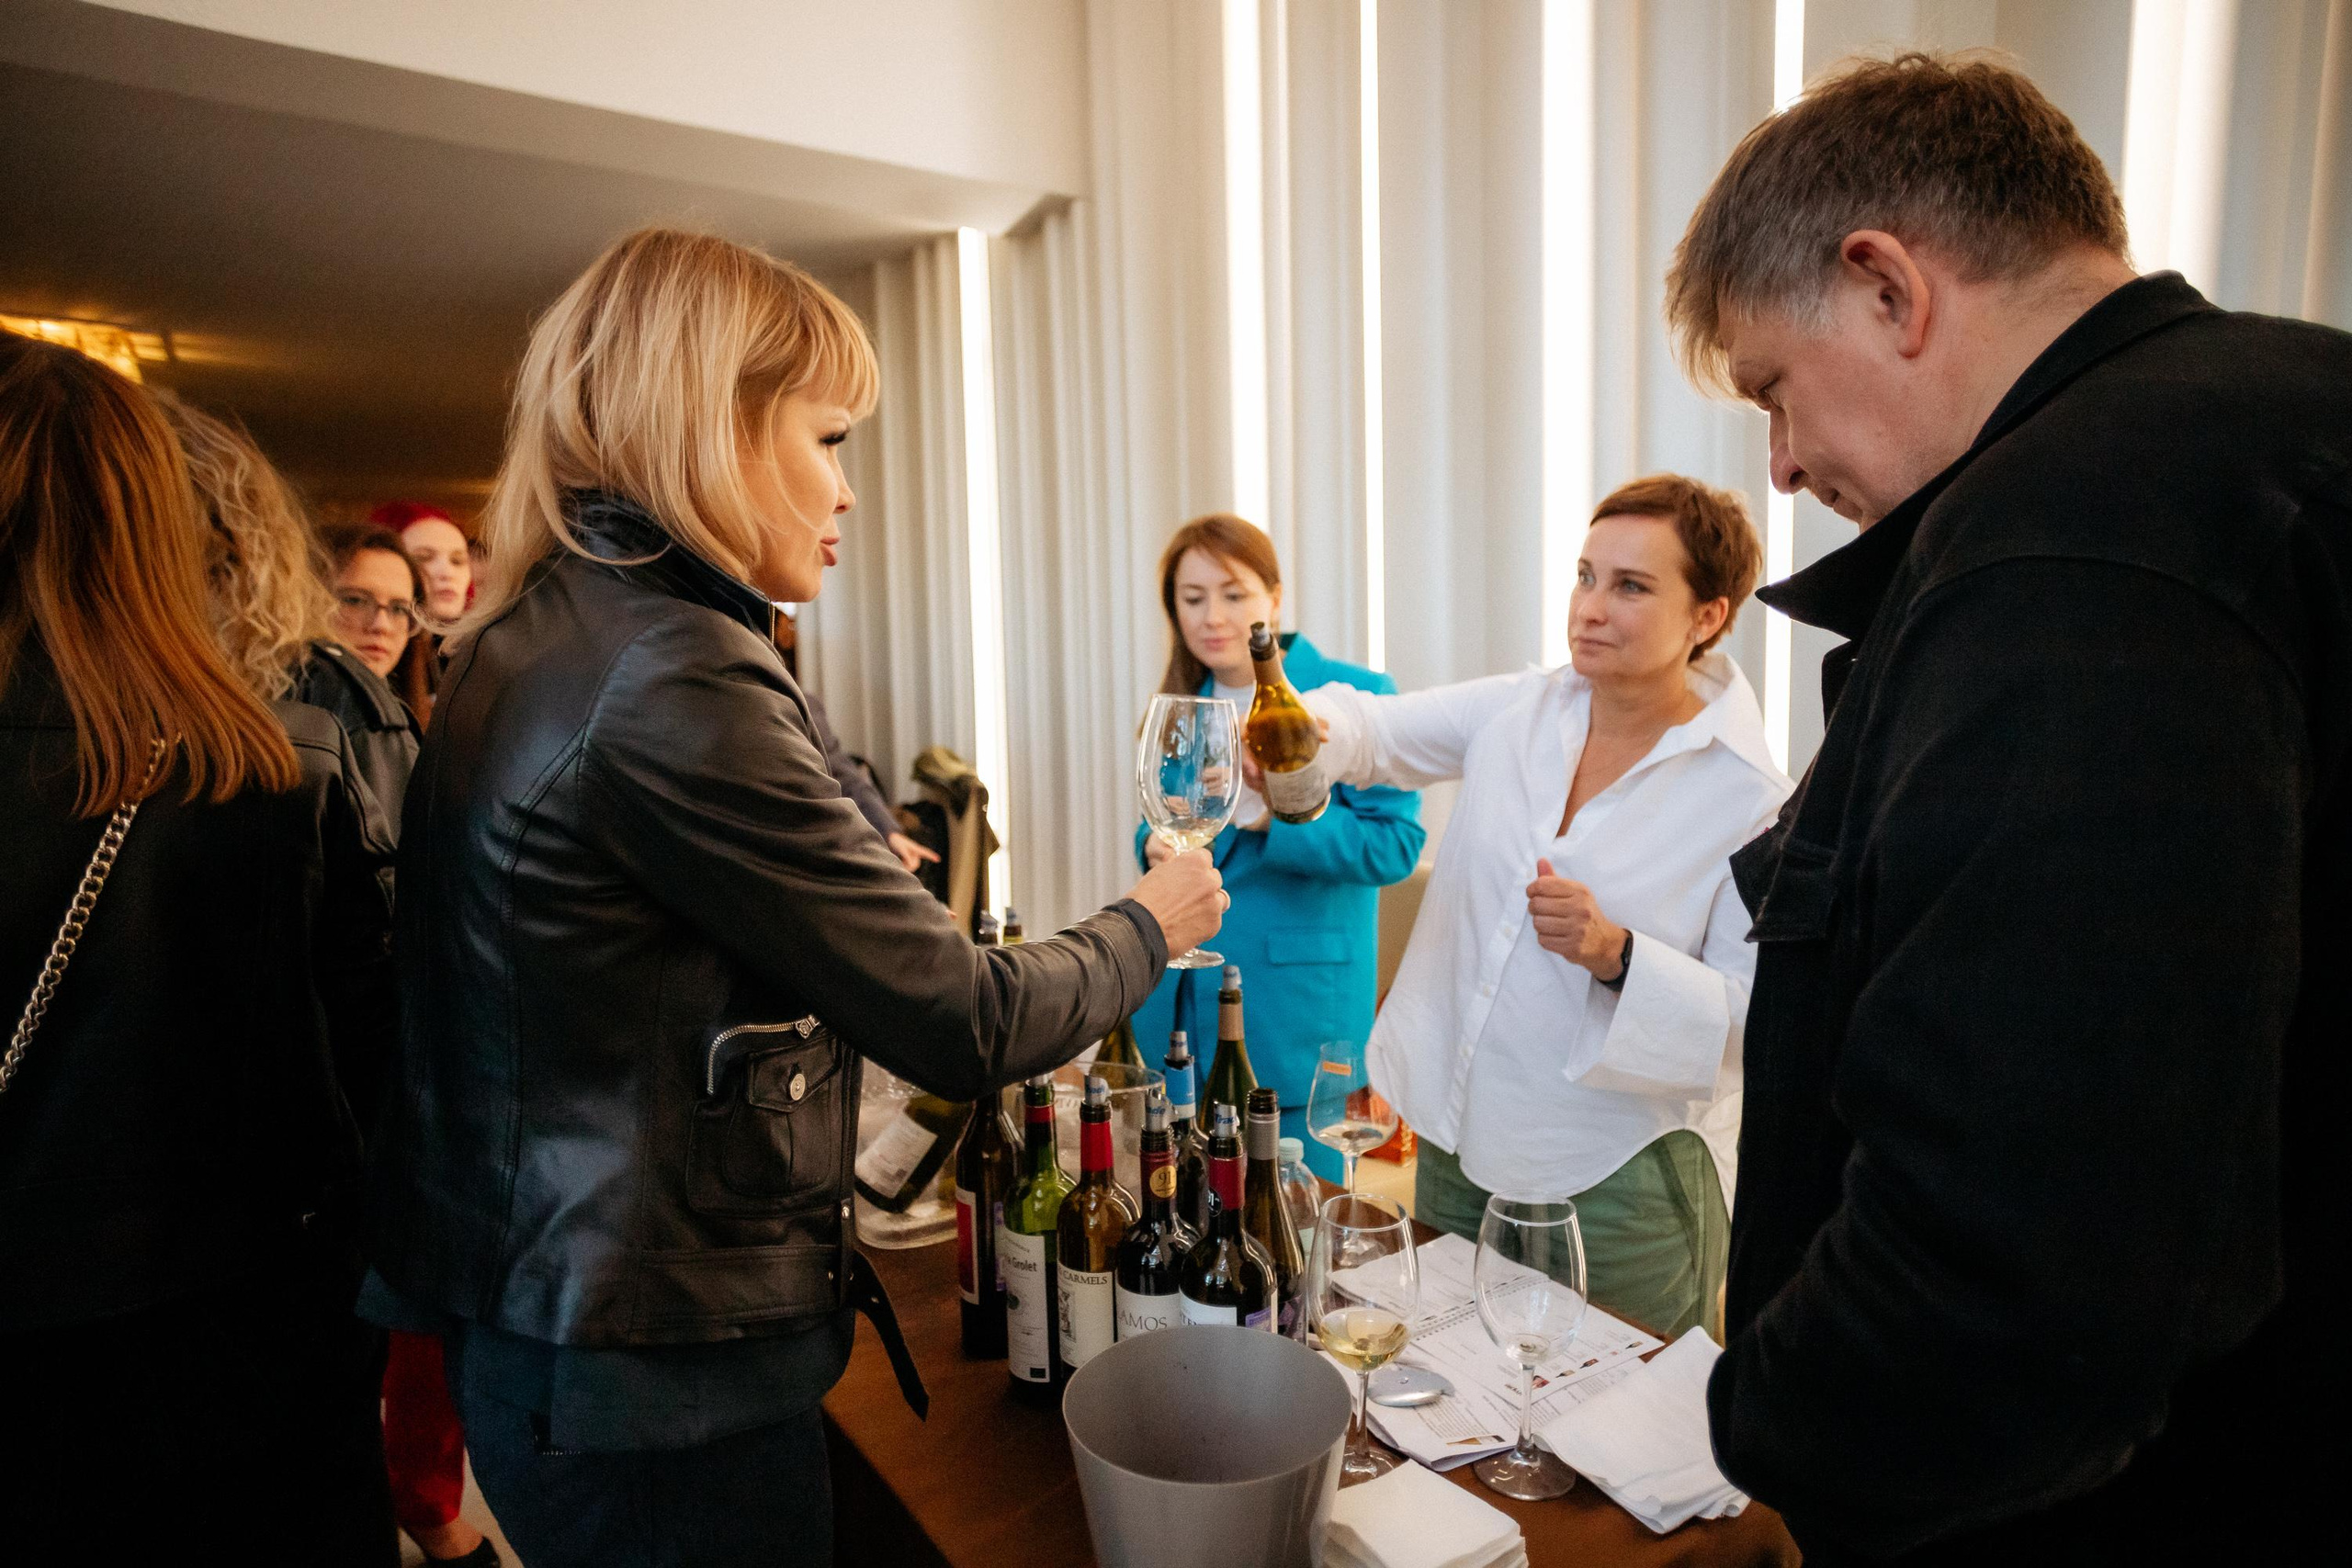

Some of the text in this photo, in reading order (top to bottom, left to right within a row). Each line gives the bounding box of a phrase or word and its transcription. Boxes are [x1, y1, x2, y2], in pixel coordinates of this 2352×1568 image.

[1159, 1170, 1171, 1187] 91
[1012, 1257, 1037, 1272] Grolet
[1063, 1270, 1108, 1285] CARMELS
